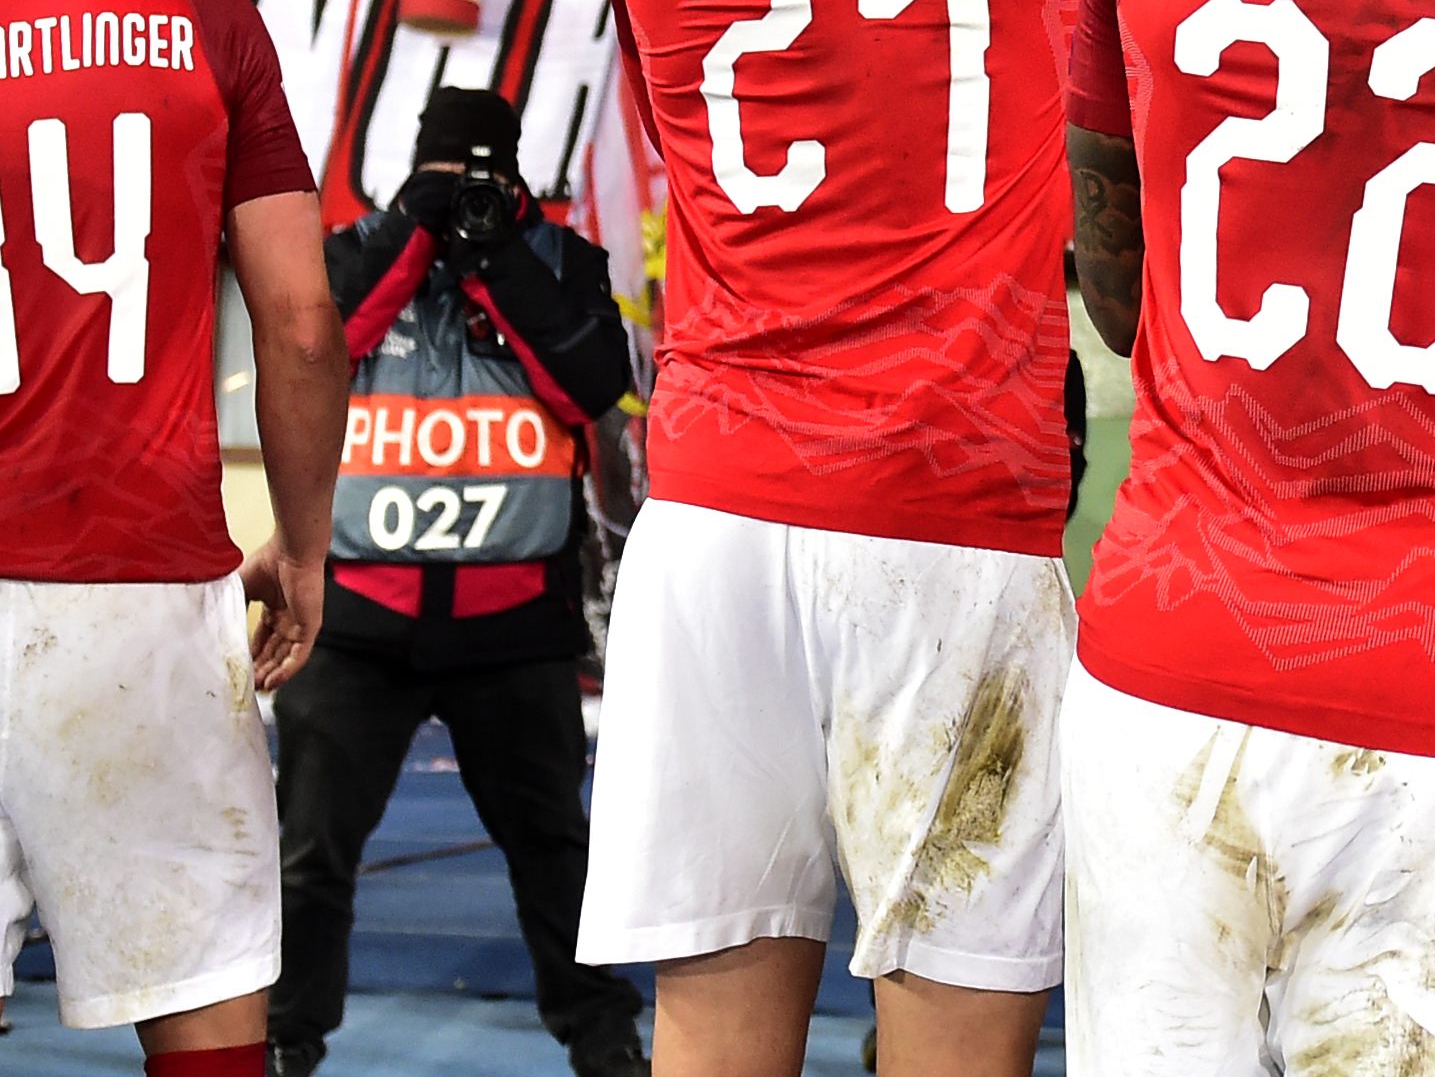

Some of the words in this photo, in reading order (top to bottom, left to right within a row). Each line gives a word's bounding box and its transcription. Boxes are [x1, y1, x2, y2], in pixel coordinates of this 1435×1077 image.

[0, 11, 195, 80] RTLINGER
[341, 407, 547, 468] PHOTO
[368, 486, 508, 551] 027
